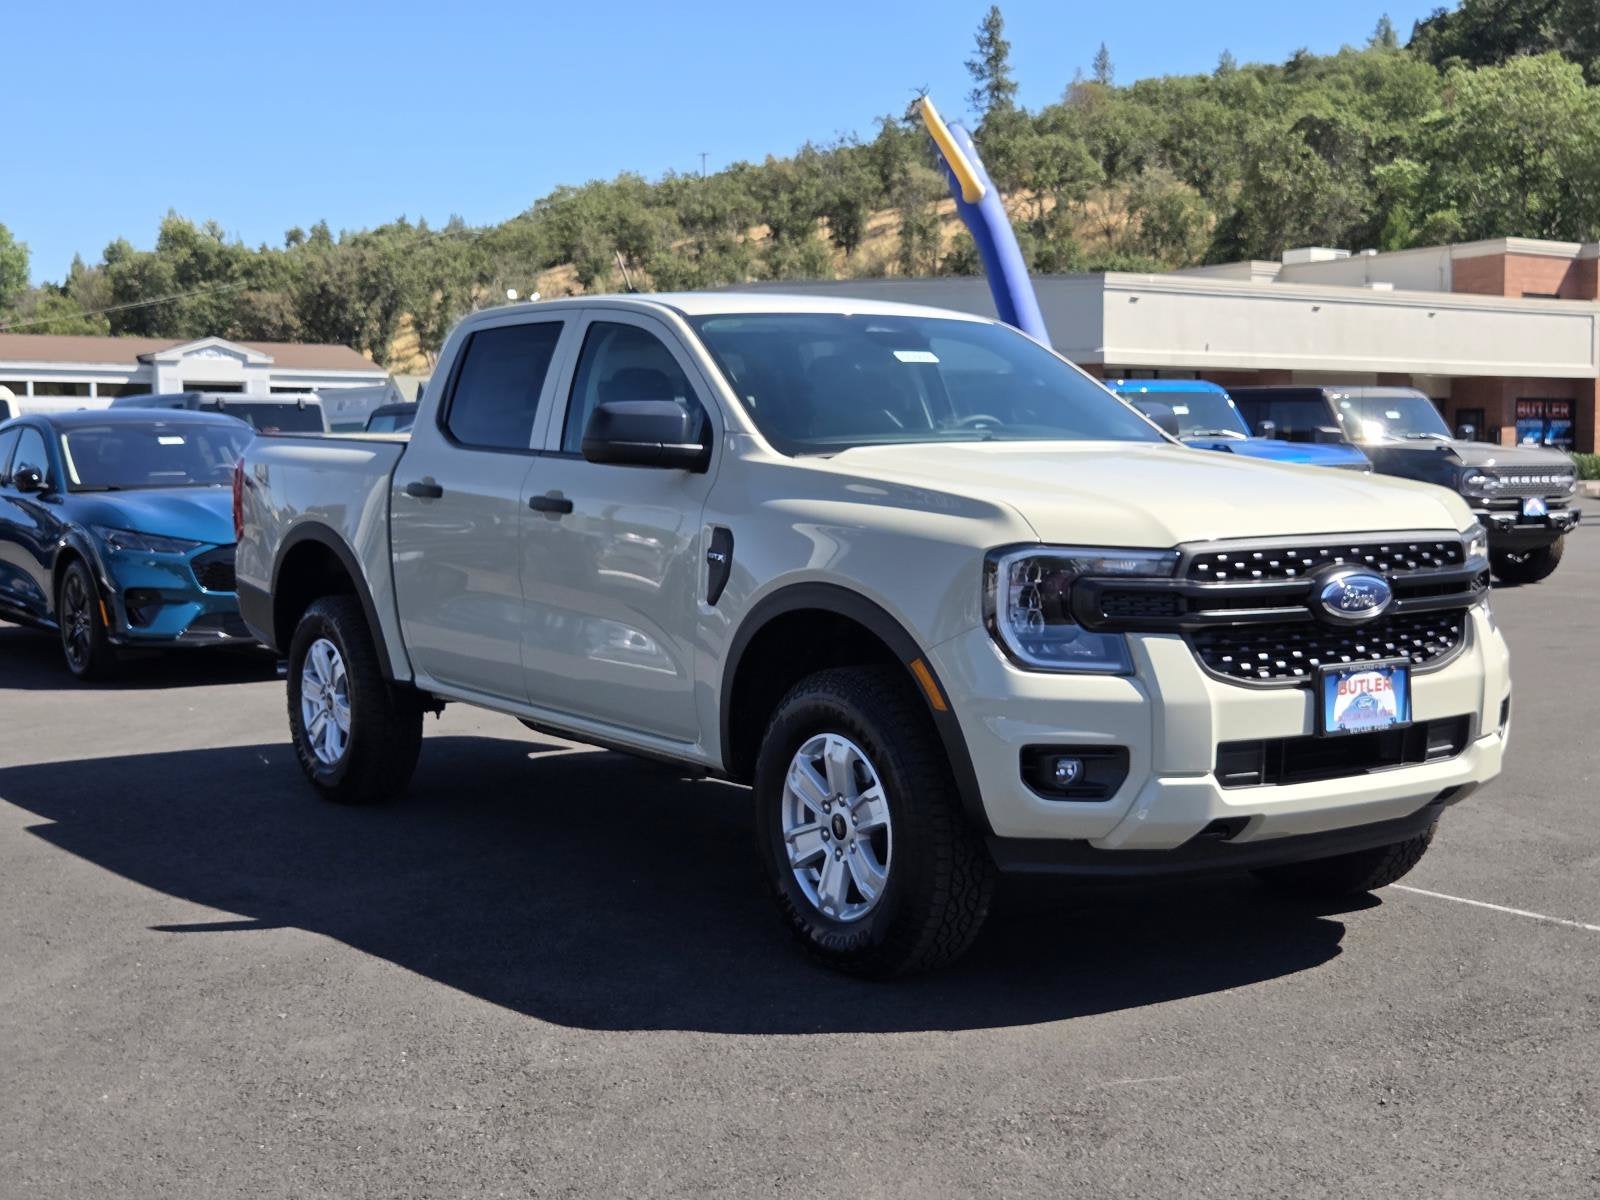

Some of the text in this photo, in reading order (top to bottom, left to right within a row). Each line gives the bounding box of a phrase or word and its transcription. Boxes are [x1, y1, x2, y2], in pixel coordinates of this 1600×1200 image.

[1517, 401, 1569, 418] BUTLER
[1341, 586, 1377, 609] Ford
[1338, 677, 1392, 695] BUTLER
